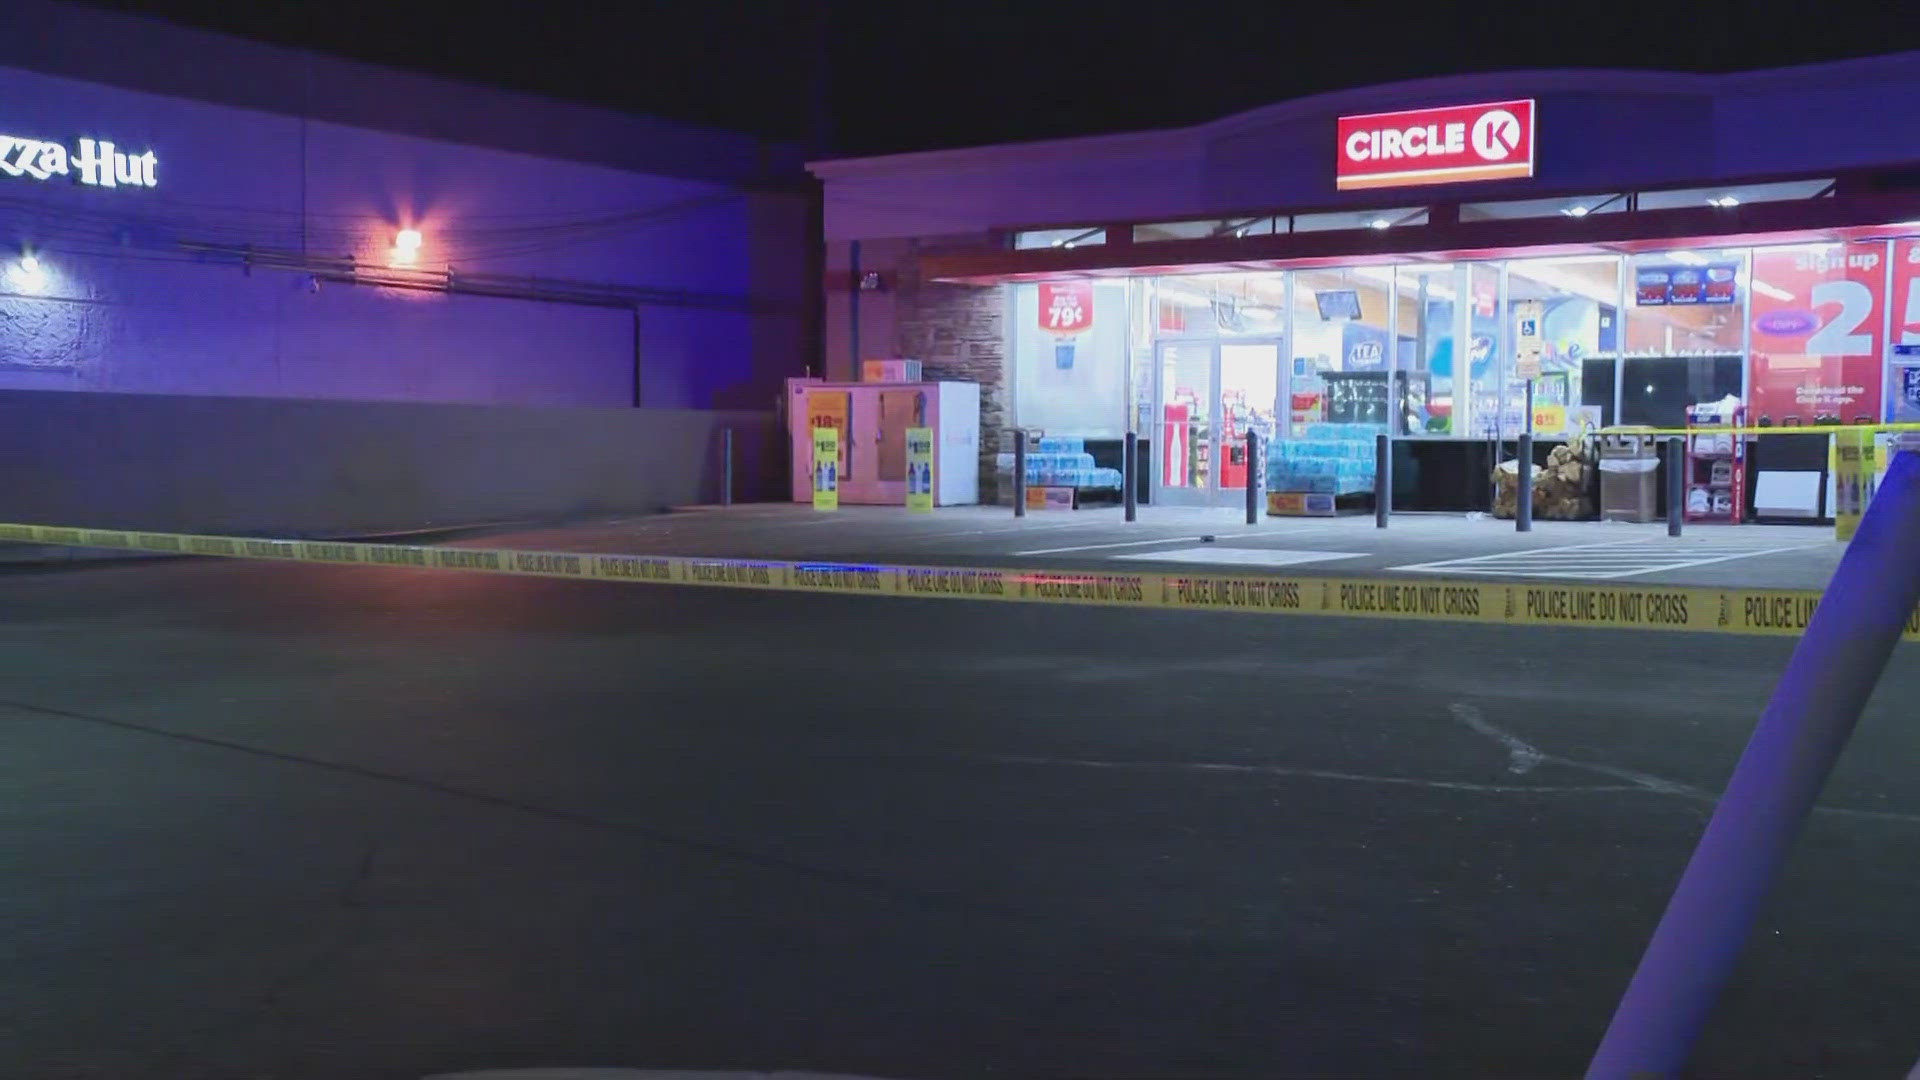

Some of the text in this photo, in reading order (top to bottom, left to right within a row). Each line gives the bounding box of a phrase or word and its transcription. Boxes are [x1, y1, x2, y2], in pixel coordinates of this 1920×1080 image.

[1345, 121, 1466, 162] CIRCLE
[70, 138, 158, 188] Hut
[1848, 253, 1880, 272] up
[1805, 280, 1874, 357] 2
[1178, 579, 1300, 608] POLICE LINE DO NOT CROSS
[1340, 584, 1375, 610] POLICE
[1378, 585, 1401, 612] LINE
[1403, 586, 1417, 613] DO
[1420, 586, 1441, 614] NOT
[1444, 587, 1480, 616] CROSS
[1527, 590, 1567, 619] POLICE
[1570, 591, 1597, 620] LINE
[1599, 592, 1616, 621] DO
[1619, 592, 1643, 622] NOT
[1646, 593, 1688, 624] CROSS
[1745, 597, 1792, 628] POLICE
[1796, 598, 1818, 629] LIN
